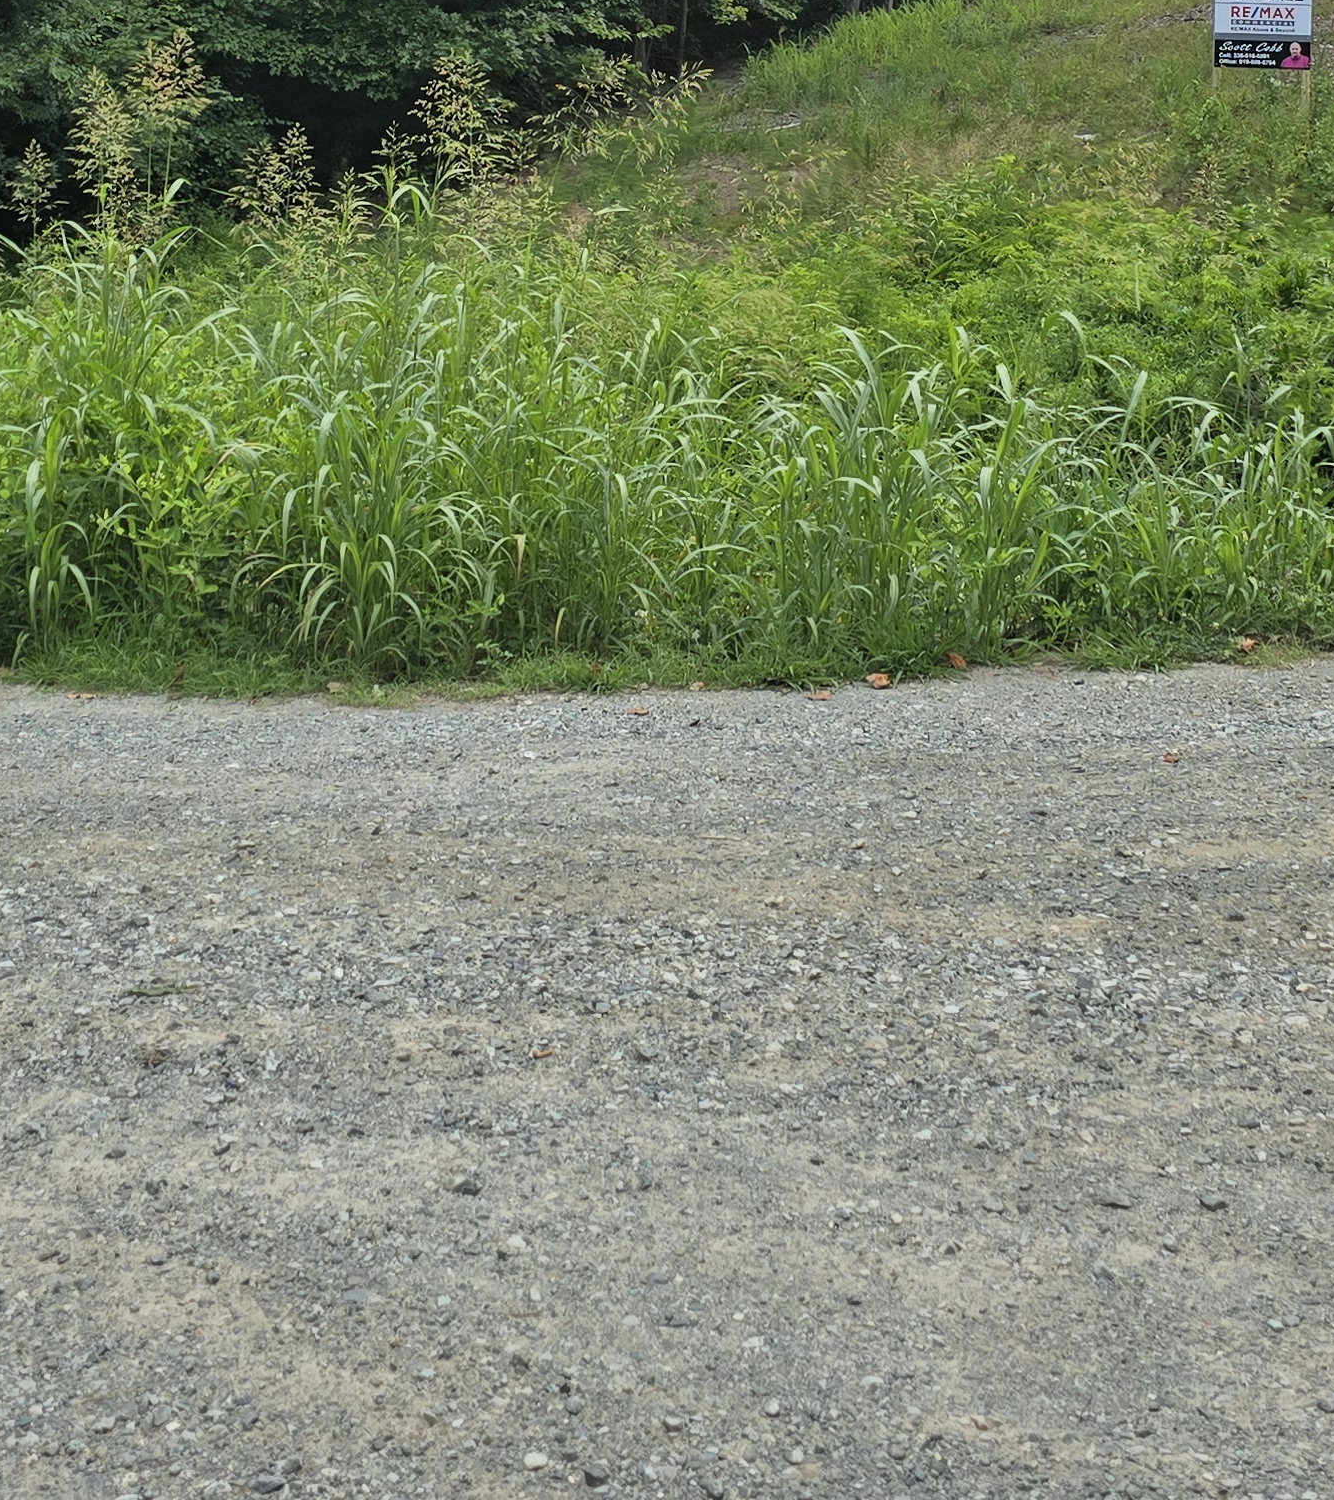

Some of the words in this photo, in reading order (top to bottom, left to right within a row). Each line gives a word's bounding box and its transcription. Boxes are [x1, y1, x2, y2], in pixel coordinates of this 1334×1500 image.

[1230, 6, 1295, 19] RE/MAX
[1219, 41, 1252, 51] Scott
[1255, 42, 1284, 52] Cobb
